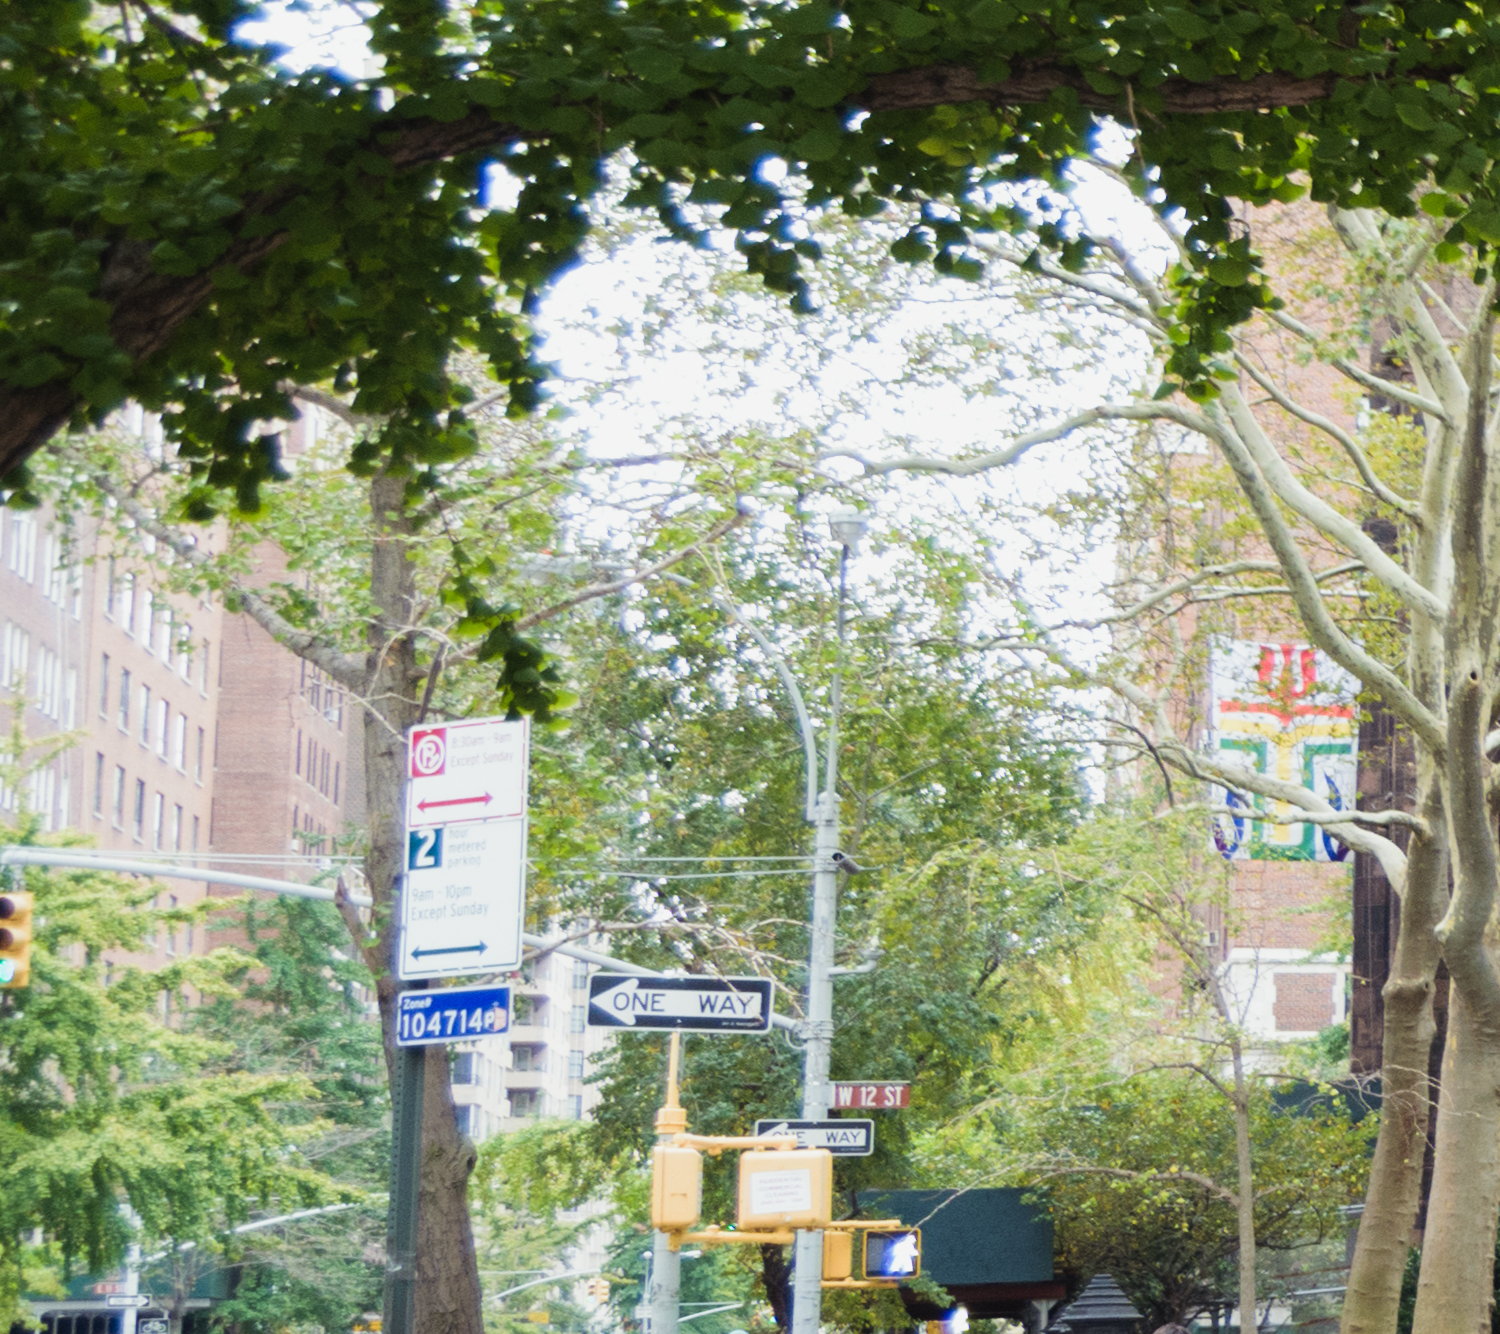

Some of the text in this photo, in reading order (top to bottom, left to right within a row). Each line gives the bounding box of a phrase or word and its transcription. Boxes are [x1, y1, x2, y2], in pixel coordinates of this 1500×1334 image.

[450, 750, 514, 768] Except Sunday
[415, 828, 437, 868] 2
[448, 839, 487, 854] metered
[447, 855, 482, 870] parking
[411, 888, 434, 902] 9am
[445, 884, 472, 900] 10pm
[411, 901, 490, 921] Except Sunday
[612, 991, 755, 1014] ONE WAY
[402, 1007, 483, 1039] 104714
[838, 1086, 905, 1107] W 12 ST
[825, 1130, 862, 1145] WAY
